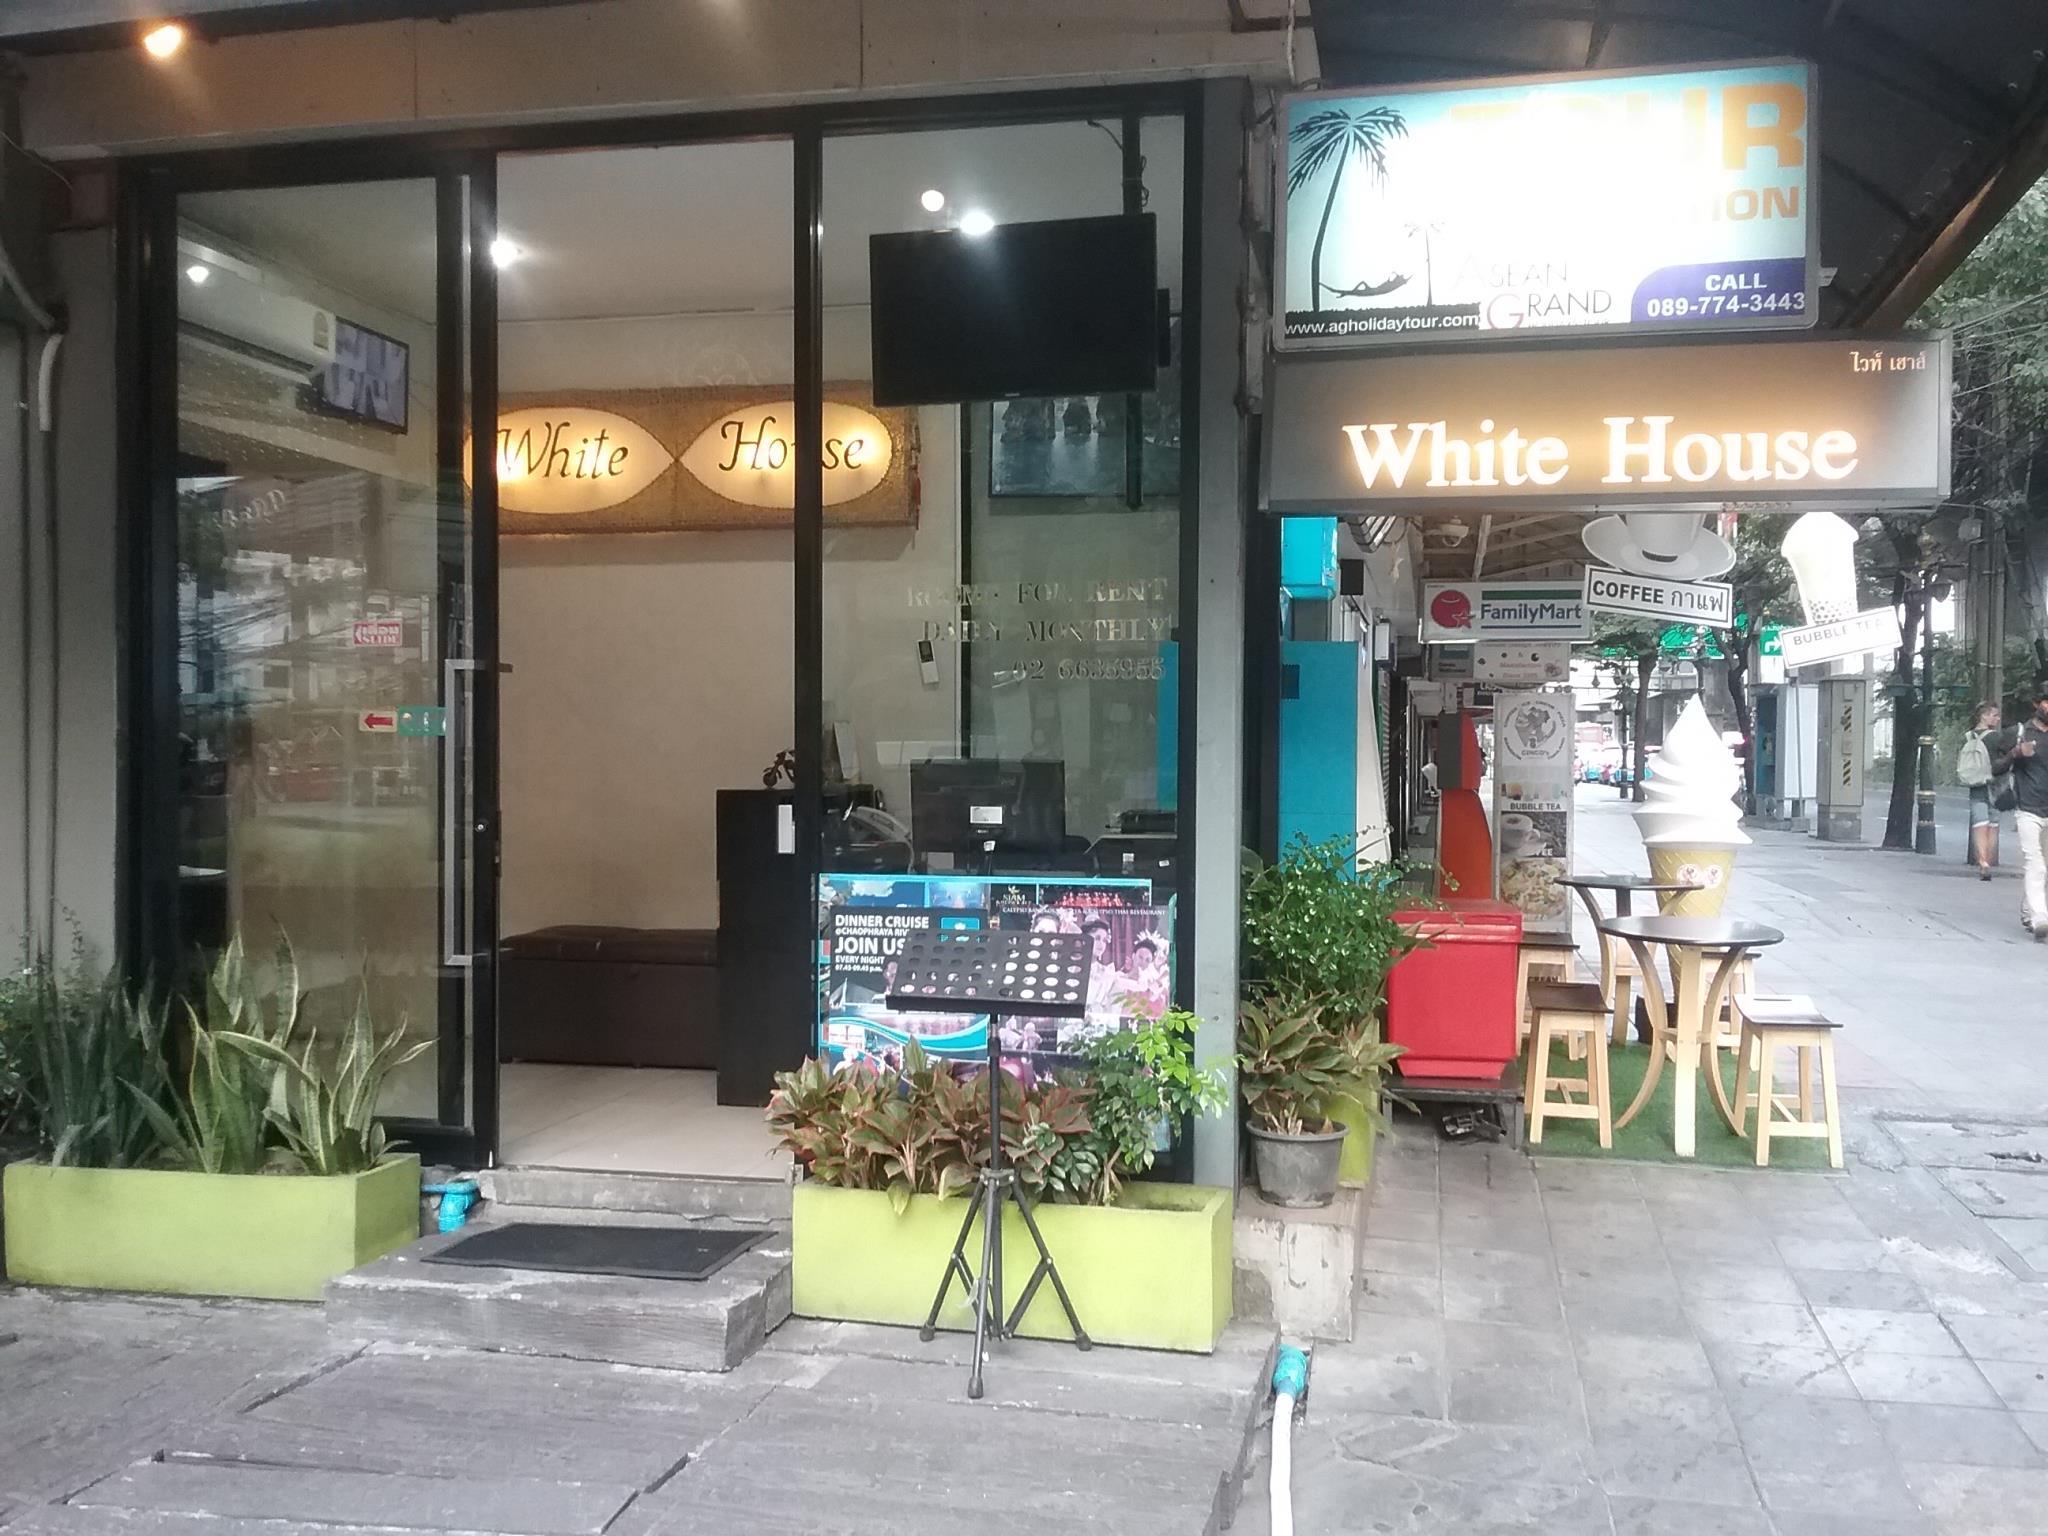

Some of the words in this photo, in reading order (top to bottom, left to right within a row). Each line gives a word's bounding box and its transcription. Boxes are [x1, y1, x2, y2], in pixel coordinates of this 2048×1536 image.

[1705, 273, 1767, 292] CALL
[1486, 290, 1612, 330] GRAND
[1647, 292, 1805, 318] 089-774-3443
[1285, 313, 1479, 335] www.agholidaytour.com
[1850, 351, 1883, 373] ไวท์
[498, 420, 629, 480] White
[719, 416, 865, 472] Hose
[1342, 418, 1571, 489] White
[1601, 415, 1859, 485] House
[1088, 577, 1169, 602] RENT
[1592, 580, 1664, 605] COFFEE
[1671, 589, 1724, 613] กาแฟ
[1480, 603, 1582, 624] FamilyMart
[1026, 617, 1168, 643] MONTHLY
[1793, 625, 1848, 646] BUBBLE
[1510, 802, 1544, 811] BUBBLE
[1546, 802, 1561, 811] TEA
[835, 914, 884, 927] DINNER
[884, 916, 930, 929] CRUISE
[835, 927, 893, 936] @CHAOPHRAYA
[835, 937, 882, 955] JOIN
[835, 956, 860, 964] EVERY
[860, 956, 885, 965] NIGHT
